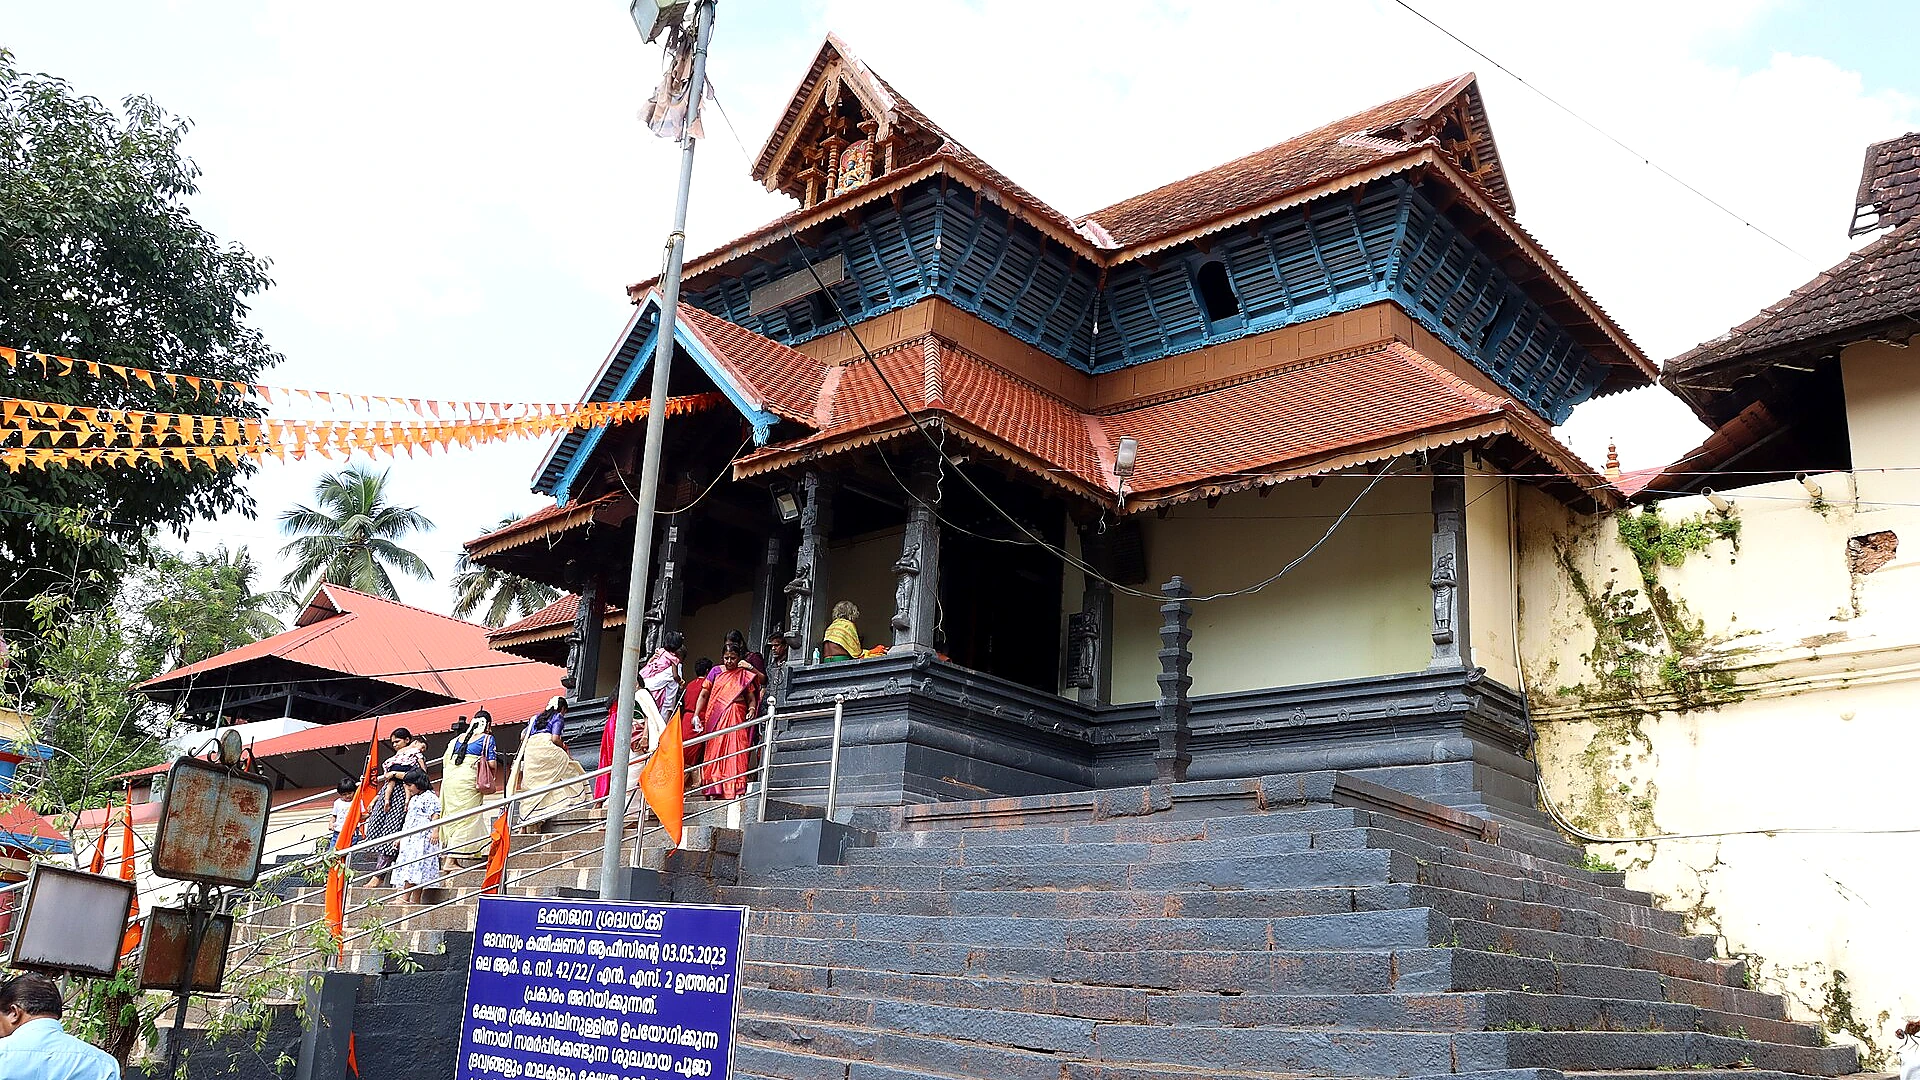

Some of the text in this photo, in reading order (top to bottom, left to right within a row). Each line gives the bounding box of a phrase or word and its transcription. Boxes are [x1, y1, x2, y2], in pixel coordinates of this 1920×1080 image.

[538, 908, 666, 930] ഭക്തജന ശ്രദ്ധയ്ക്ക്
[483, 933, 523, 953] ദേവസ്വം
[662, 944, 726, 966] 03.05.2023
[476, 956, 492, 971] ലെ
[493, 957, 519, 976] ആർ.
[535, 959, 553, 977] സി.
[597, 966, 626, 985] എൻ.
[629, 968, 661, 989] എസ്.
[665, 971, 672, 988] 2
[675, 973, 730, 994] ഉത്തരവ്
[524, 986, 657, 1014] പ്രകാരം അറിയിക്കുന്നത്.
[473, 1004, 507, 1025] ക്ഷേത്ര
[620, 1022, 718, 1051] ഉപയോഗിക്കുന്ന
[473, 1026, 512, 1048] തിനായി
[612, 1048, 672, 1071] ശുദ്ധമായ
[675, 1057, 711, 1078] പൂജാ
